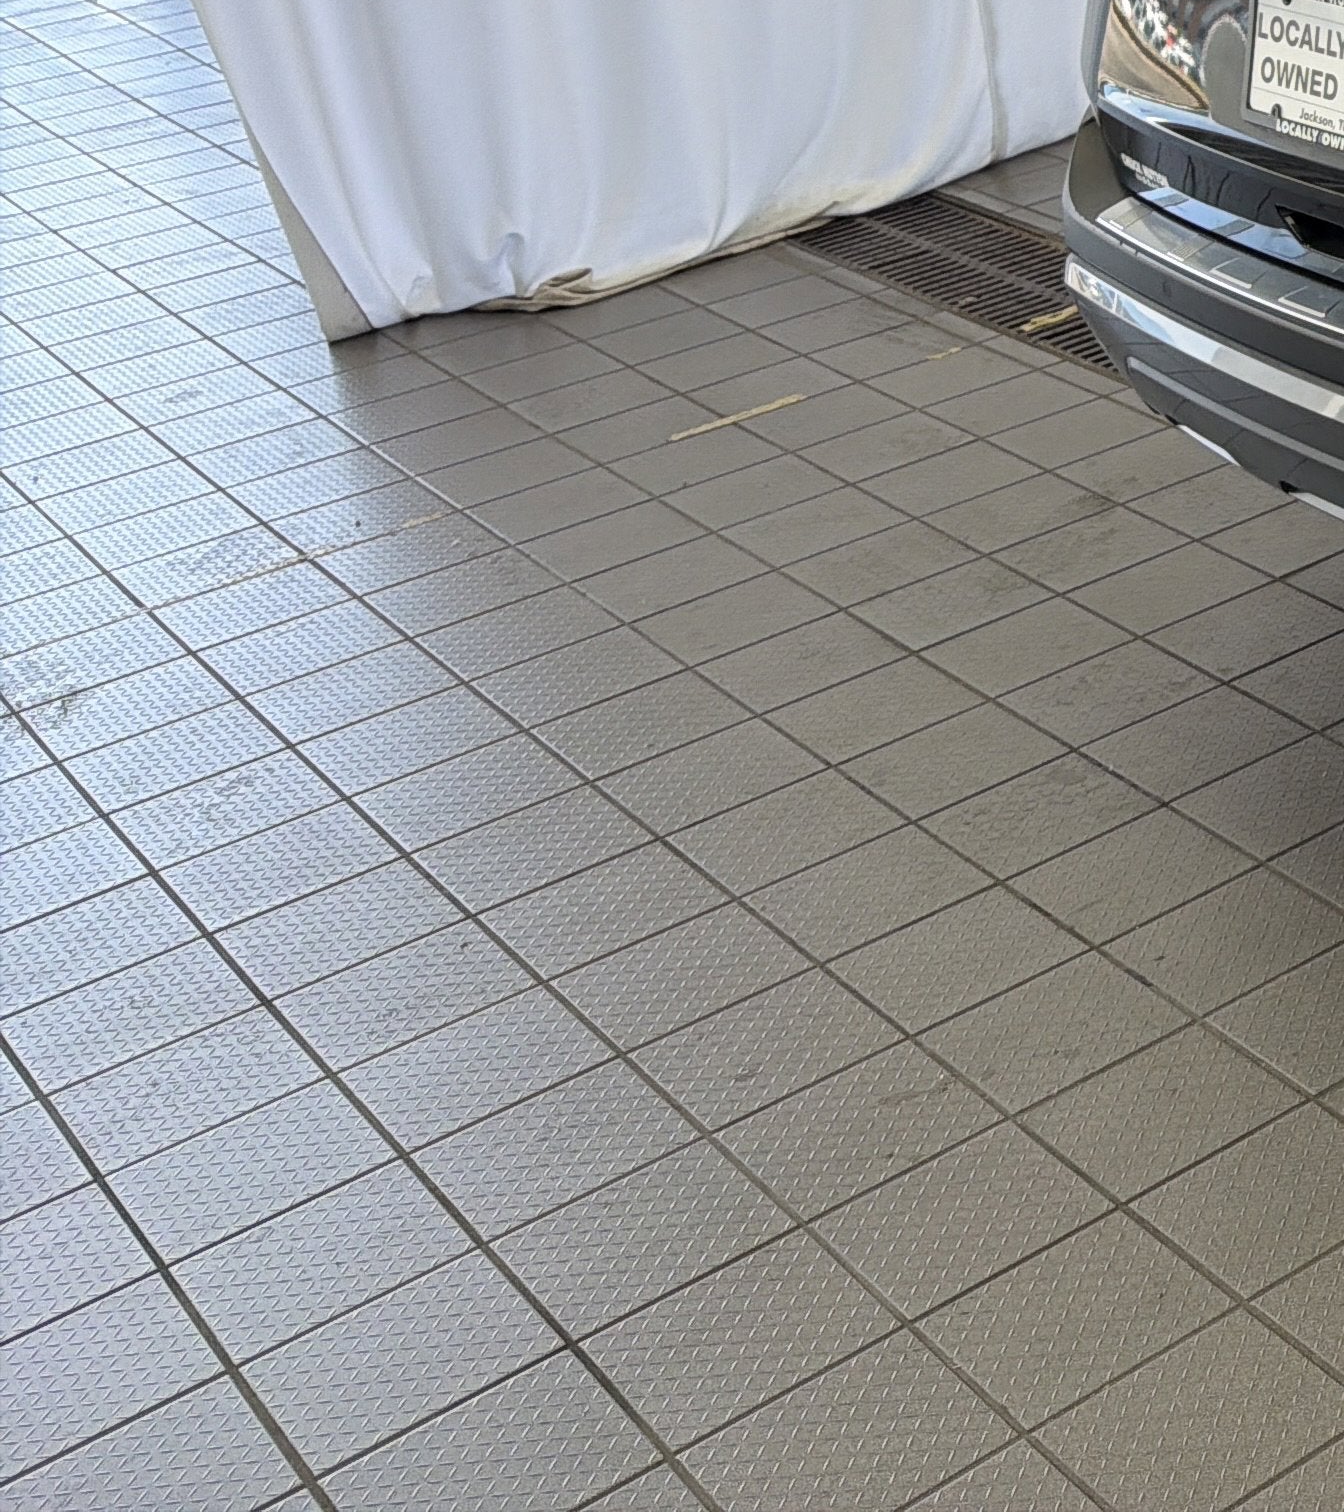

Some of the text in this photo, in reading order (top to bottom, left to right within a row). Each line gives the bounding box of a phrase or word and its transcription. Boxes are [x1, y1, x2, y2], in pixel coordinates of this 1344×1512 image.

[1260, 56, 1339, 101] OWNED
[1275, 118, 1321, 143] LOCALLY
[1299, 107, 1335, 129] Jackson,
